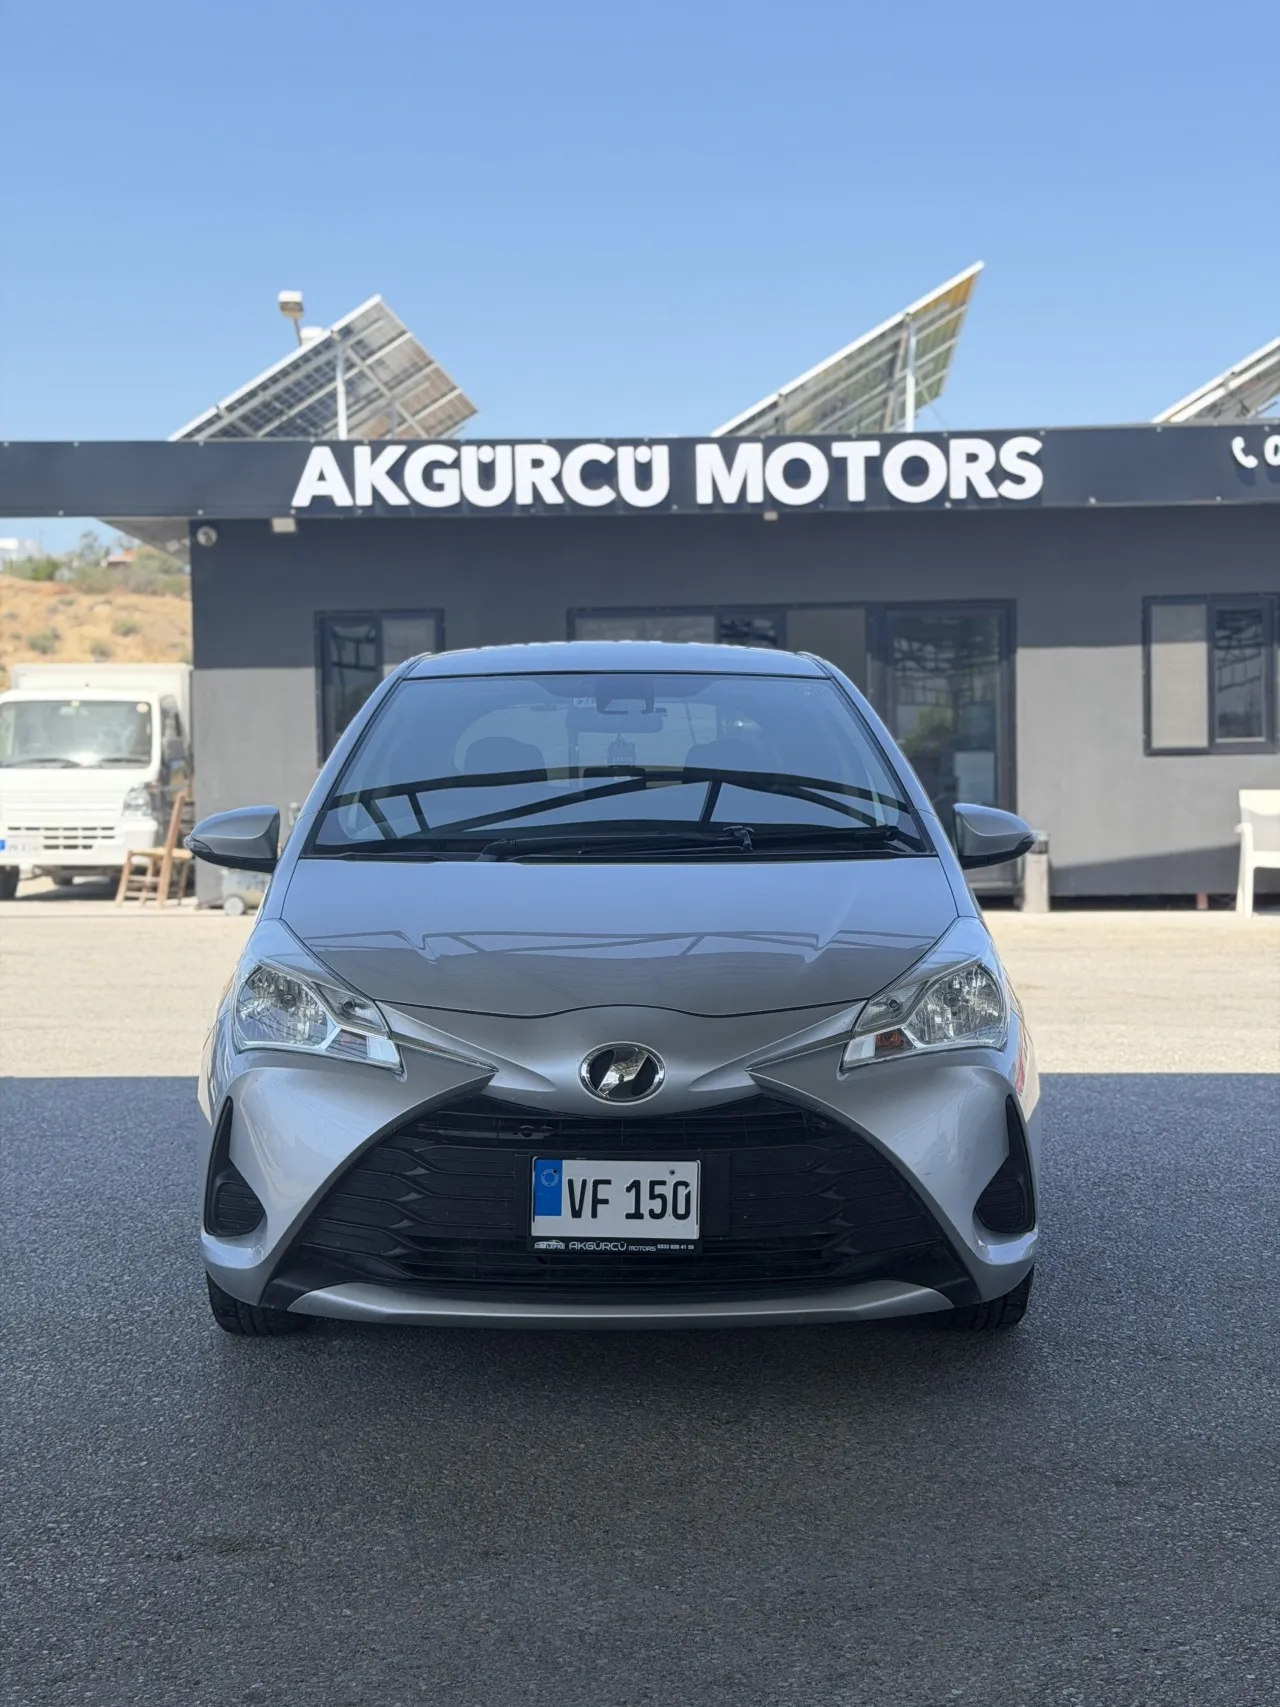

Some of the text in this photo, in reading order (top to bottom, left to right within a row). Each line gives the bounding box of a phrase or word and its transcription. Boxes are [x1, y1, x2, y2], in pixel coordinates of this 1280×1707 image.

[291, 436, 1044, 508] AKGÜRCÜ MOTORS
[567, 1178, 692, 1221] VF 150
[569, 1240, 627, 1251] AKGÜRCÜ
